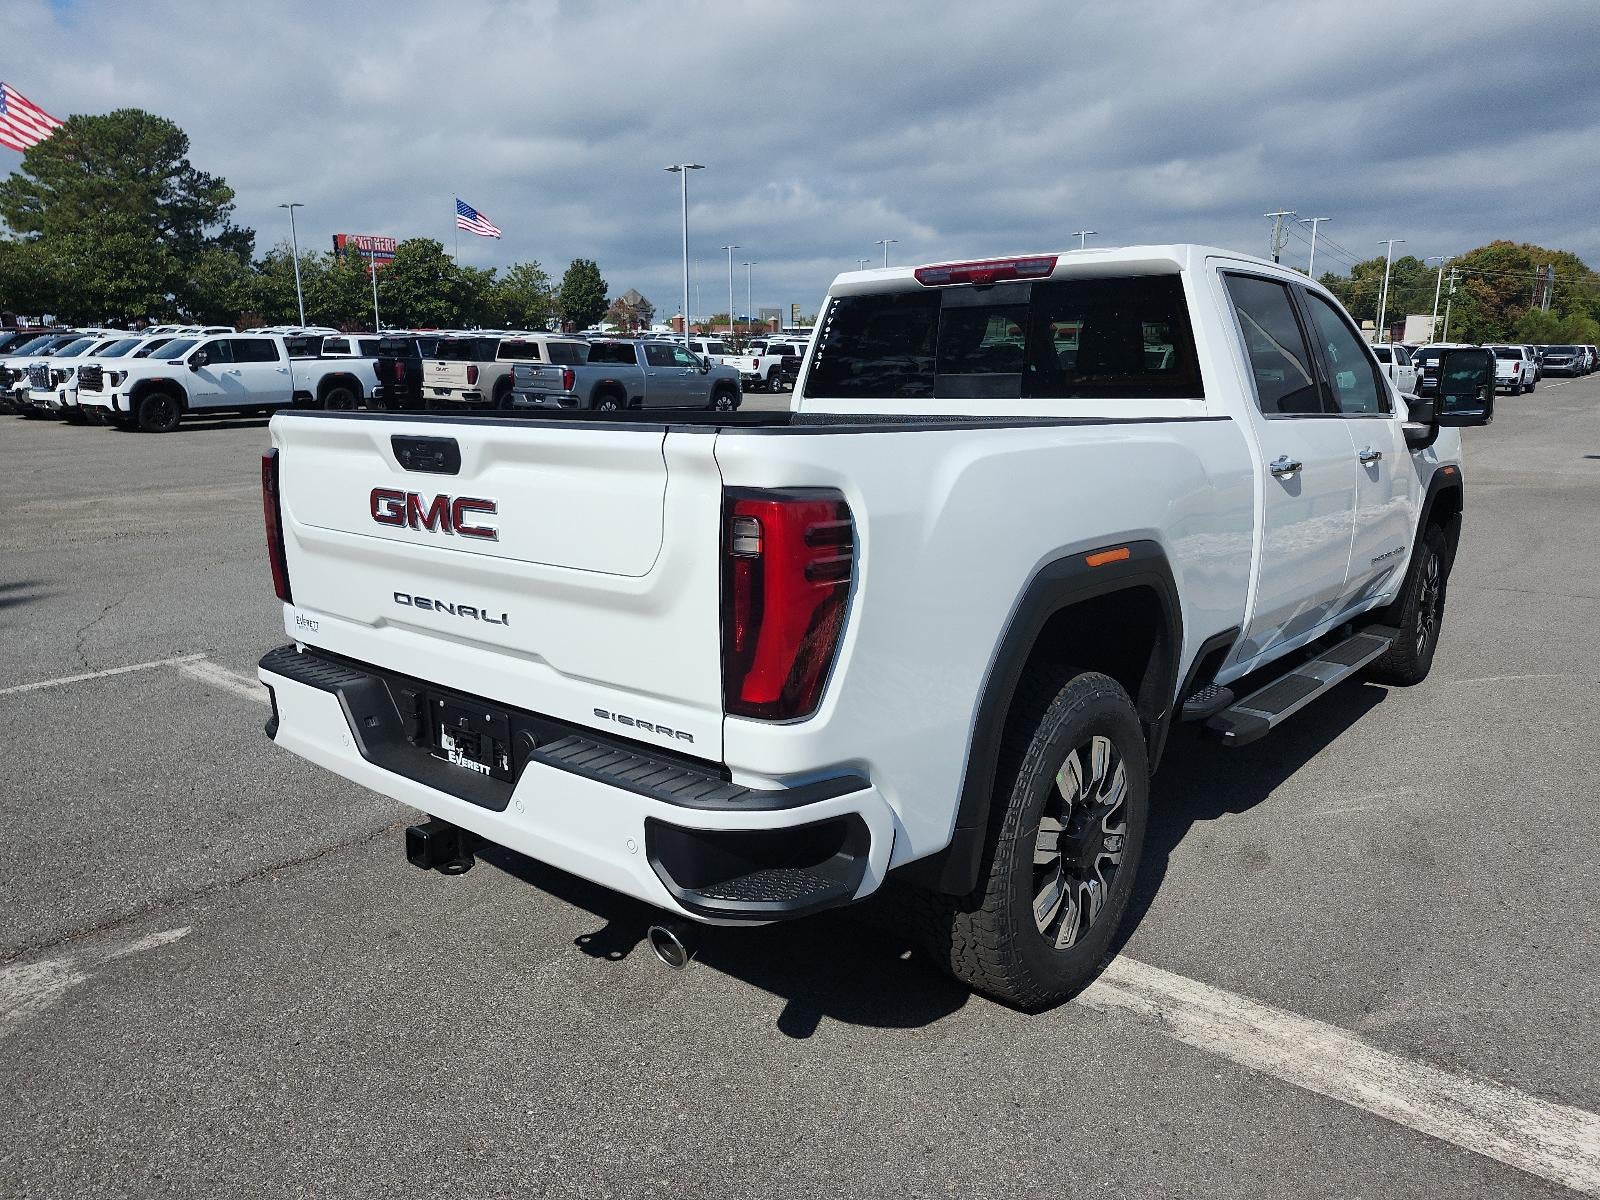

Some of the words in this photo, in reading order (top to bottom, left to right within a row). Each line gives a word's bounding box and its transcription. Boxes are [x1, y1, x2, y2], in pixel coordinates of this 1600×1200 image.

[373, 237, 395, 252] HERE
[370, 486, 499, 542] GMC
[393, 591, 510, 627] DENALI
[593, 707, 695, 744] SIERRA
[448, 749, 491, 775] EVERETT
